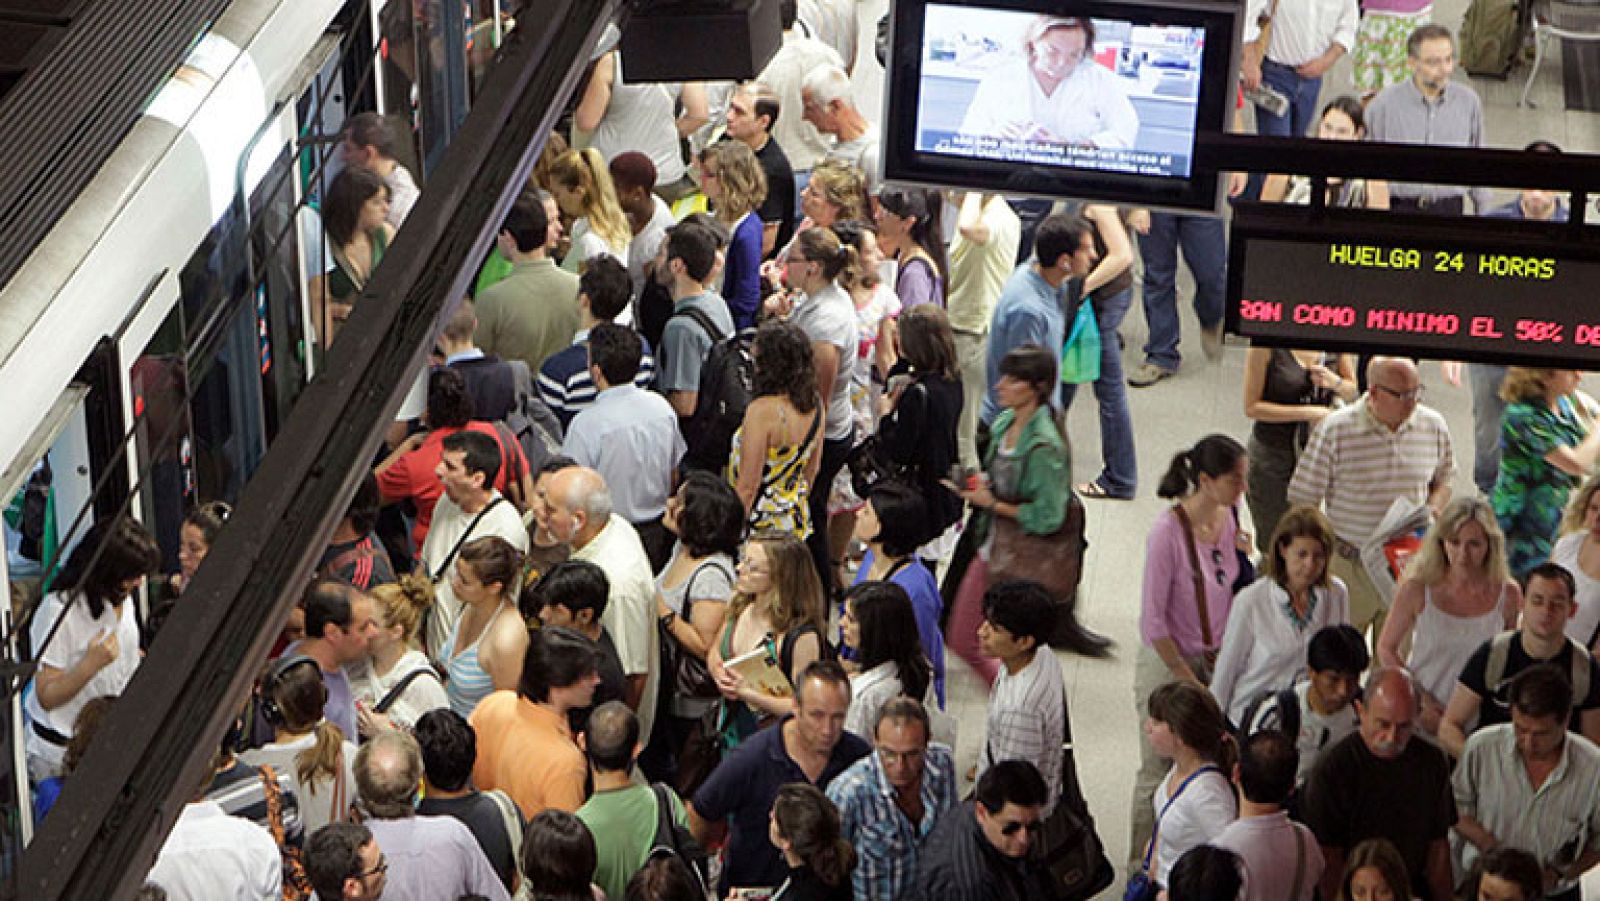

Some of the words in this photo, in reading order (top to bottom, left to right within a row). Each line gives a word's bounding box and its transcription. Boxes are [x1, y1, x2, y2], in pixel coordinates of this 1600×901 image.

[1330, 243, 1421, 268] HUELGA
[1434, 251, 1465, 272] 24
[1478, 255, 1556, 279] HORAS
[1292, 304, 1357, 327] COMO
[1366, 310, 1460, 335] MINIMO
[1469, 317, 1504, 339] EL
[1515, 320, 1564, 343] 50%
